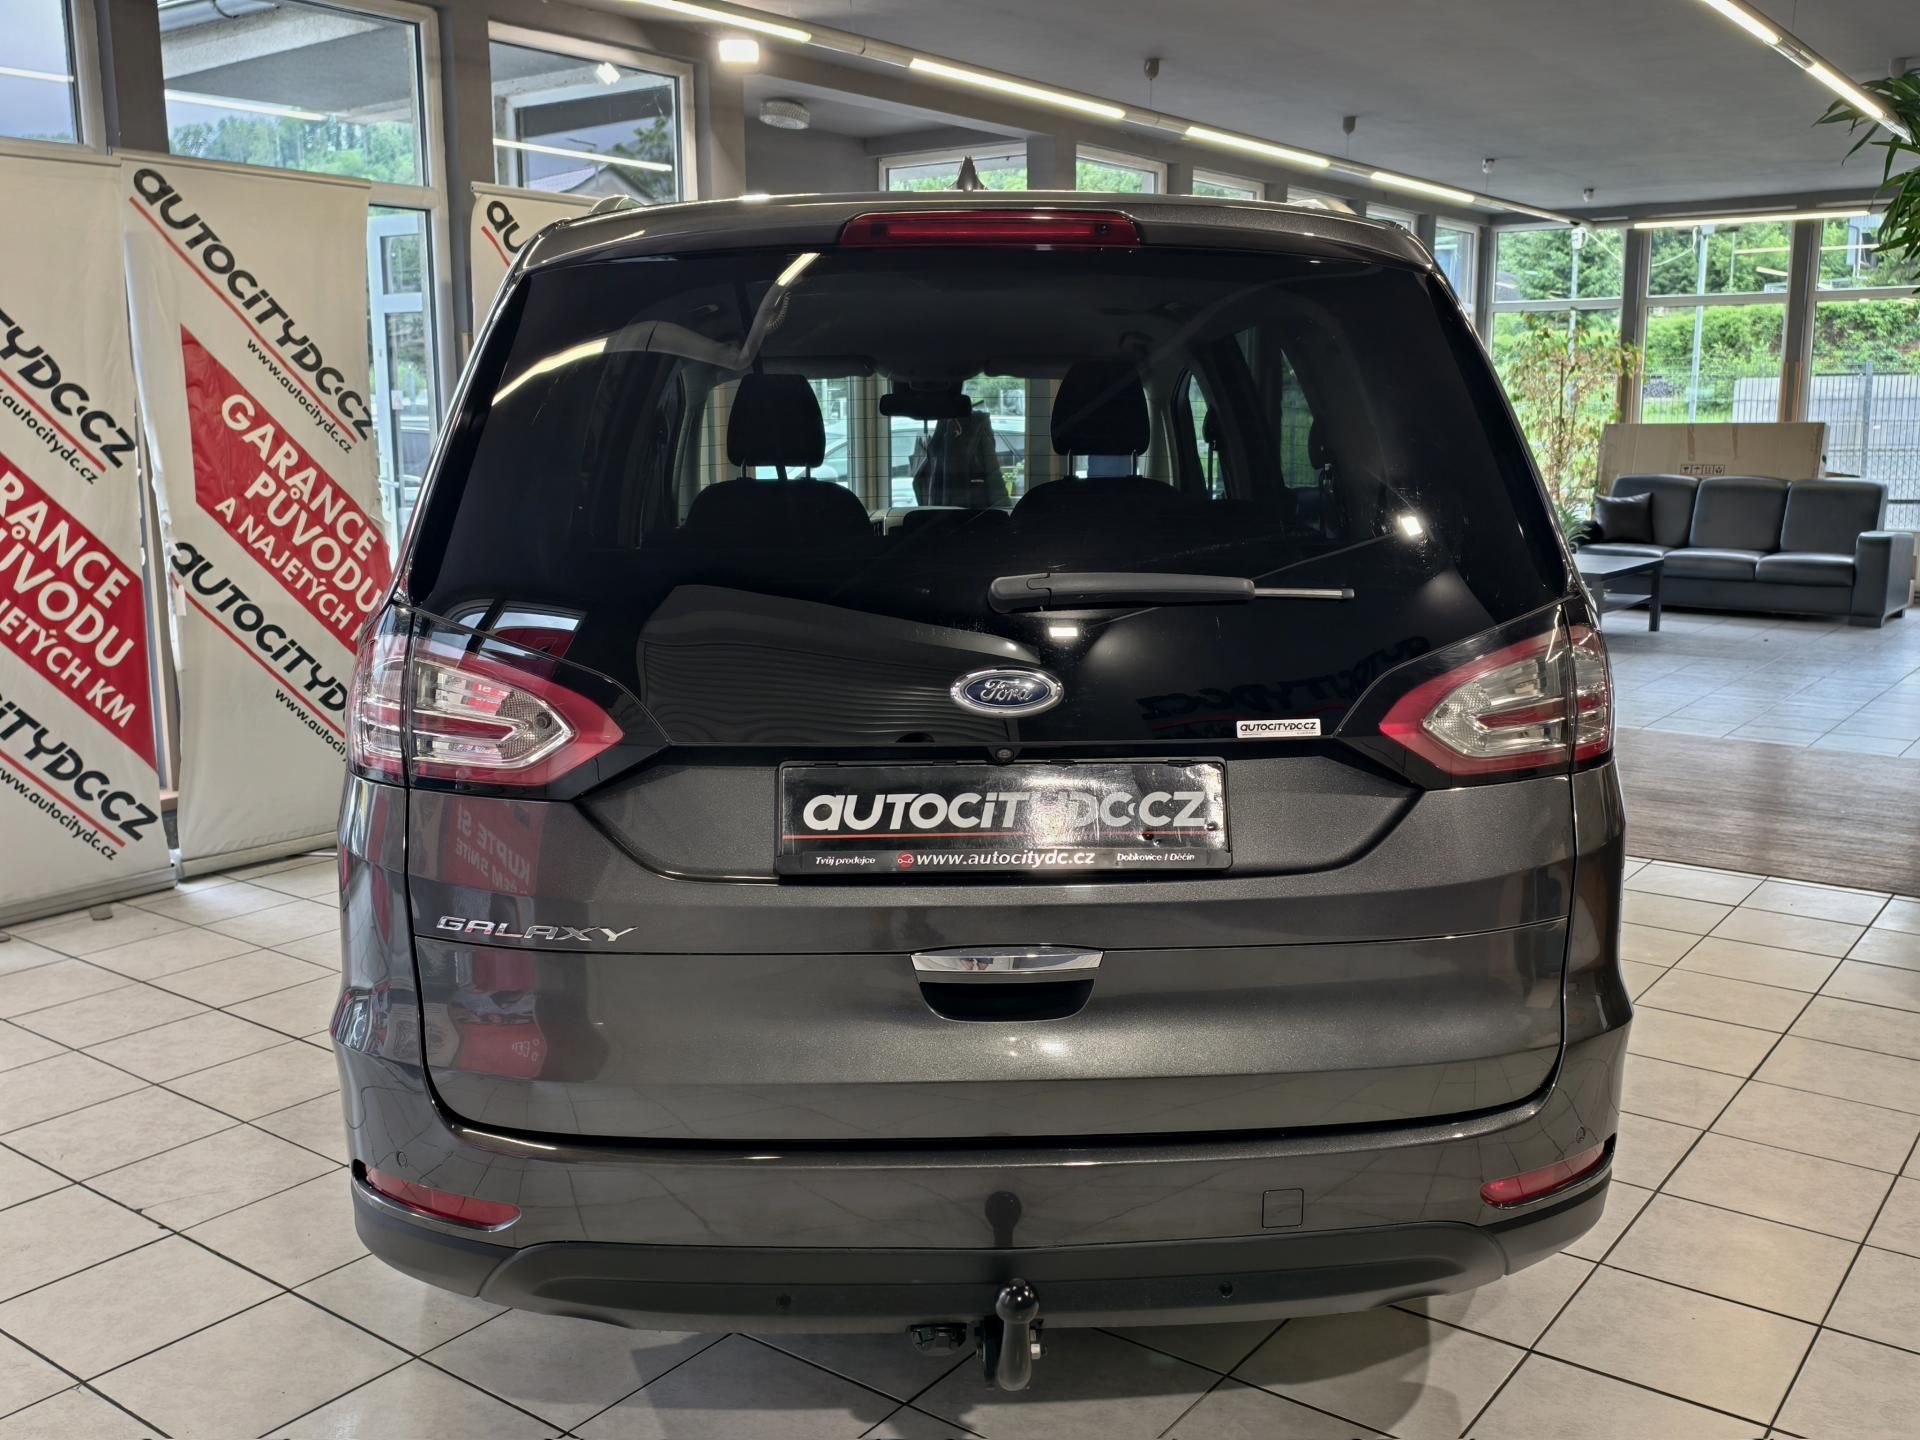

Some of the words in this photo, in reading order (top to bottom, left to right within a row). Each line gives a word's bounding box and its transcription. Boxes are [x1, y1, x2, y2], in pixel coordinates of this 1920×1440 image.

[246, 338, 353, 454] www.autocitydc.cz
[221, 394, 378, 561] GARANCE
[214, 496, 236, 524] A
[237, 514, 354, 631] NAJETÝCH
[244, 470, 383, 613] PŮVODU
[85, 678, 136, 728] KM
[980, 679, 1034, 702] Ford
[0, 767, 118, 861] ww.autocitydc.cz
[836, 856, 876, 866] prodejce
[916, 849, 1096, 869] www.autocitydc.cz
[1116, 852, 1163, 861] Dobkovice
[436, 915, 638, 942] GALAXY
